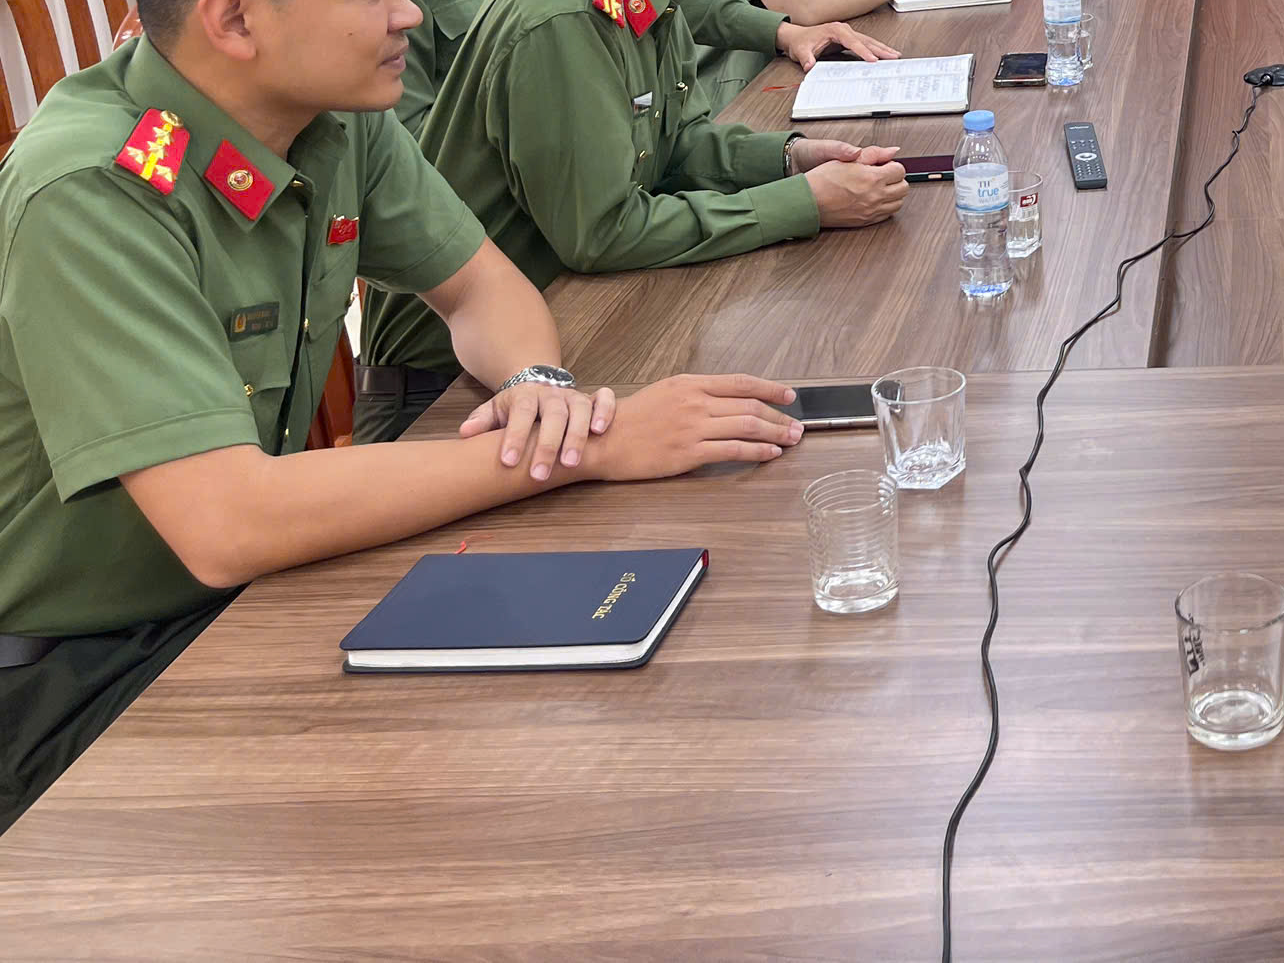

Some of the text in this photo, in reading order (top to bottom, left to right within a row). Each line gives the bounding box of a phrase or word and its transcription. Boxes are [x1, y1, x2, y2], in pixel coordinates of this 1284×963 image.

[977, 187, 1000, 198] true
[591, 572, 636, 619] SỔ CÔNG TÁC
